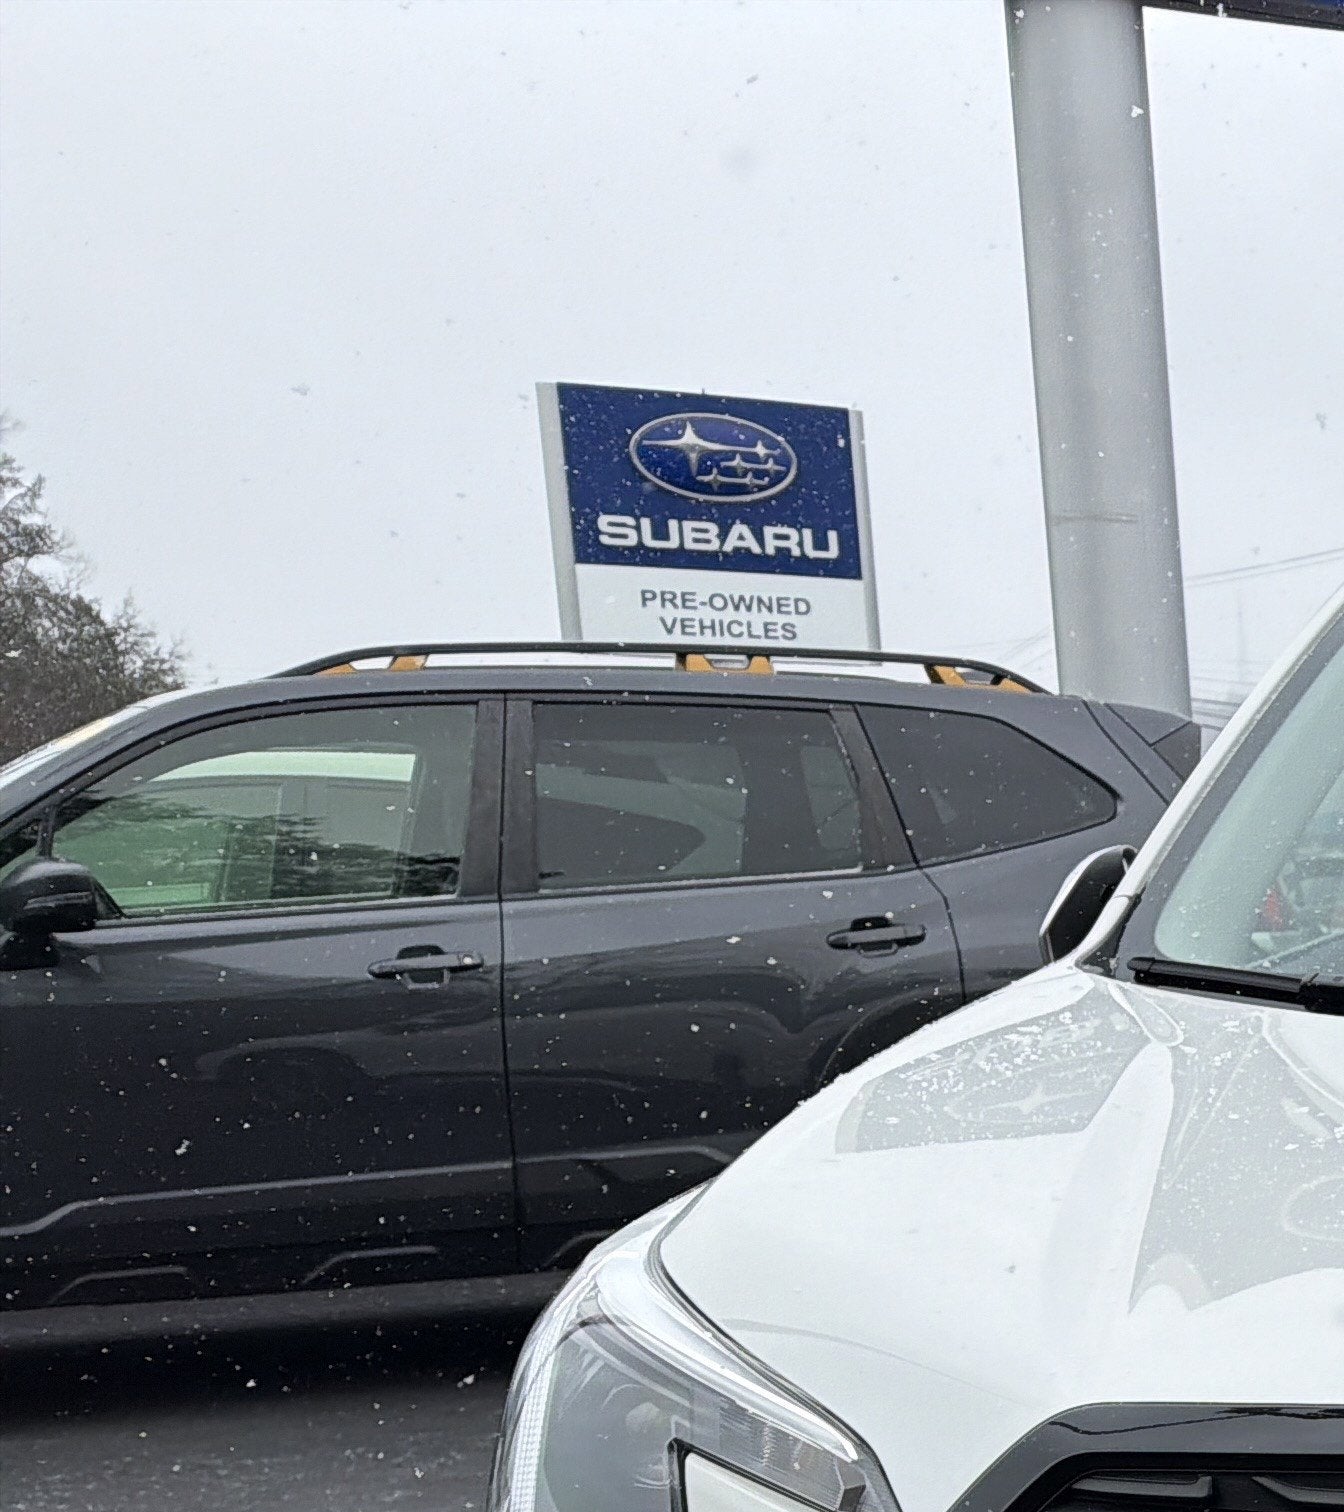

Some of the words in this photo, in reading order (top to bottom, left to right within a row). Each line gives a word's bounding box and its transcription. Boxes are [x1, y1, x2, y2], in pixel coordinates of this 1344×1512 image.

[597, 514, 839, 560] SUBARU
[640, 589, 811, 616] PRE-OWNED
[659, 616, 798, 641] VEHICLES
